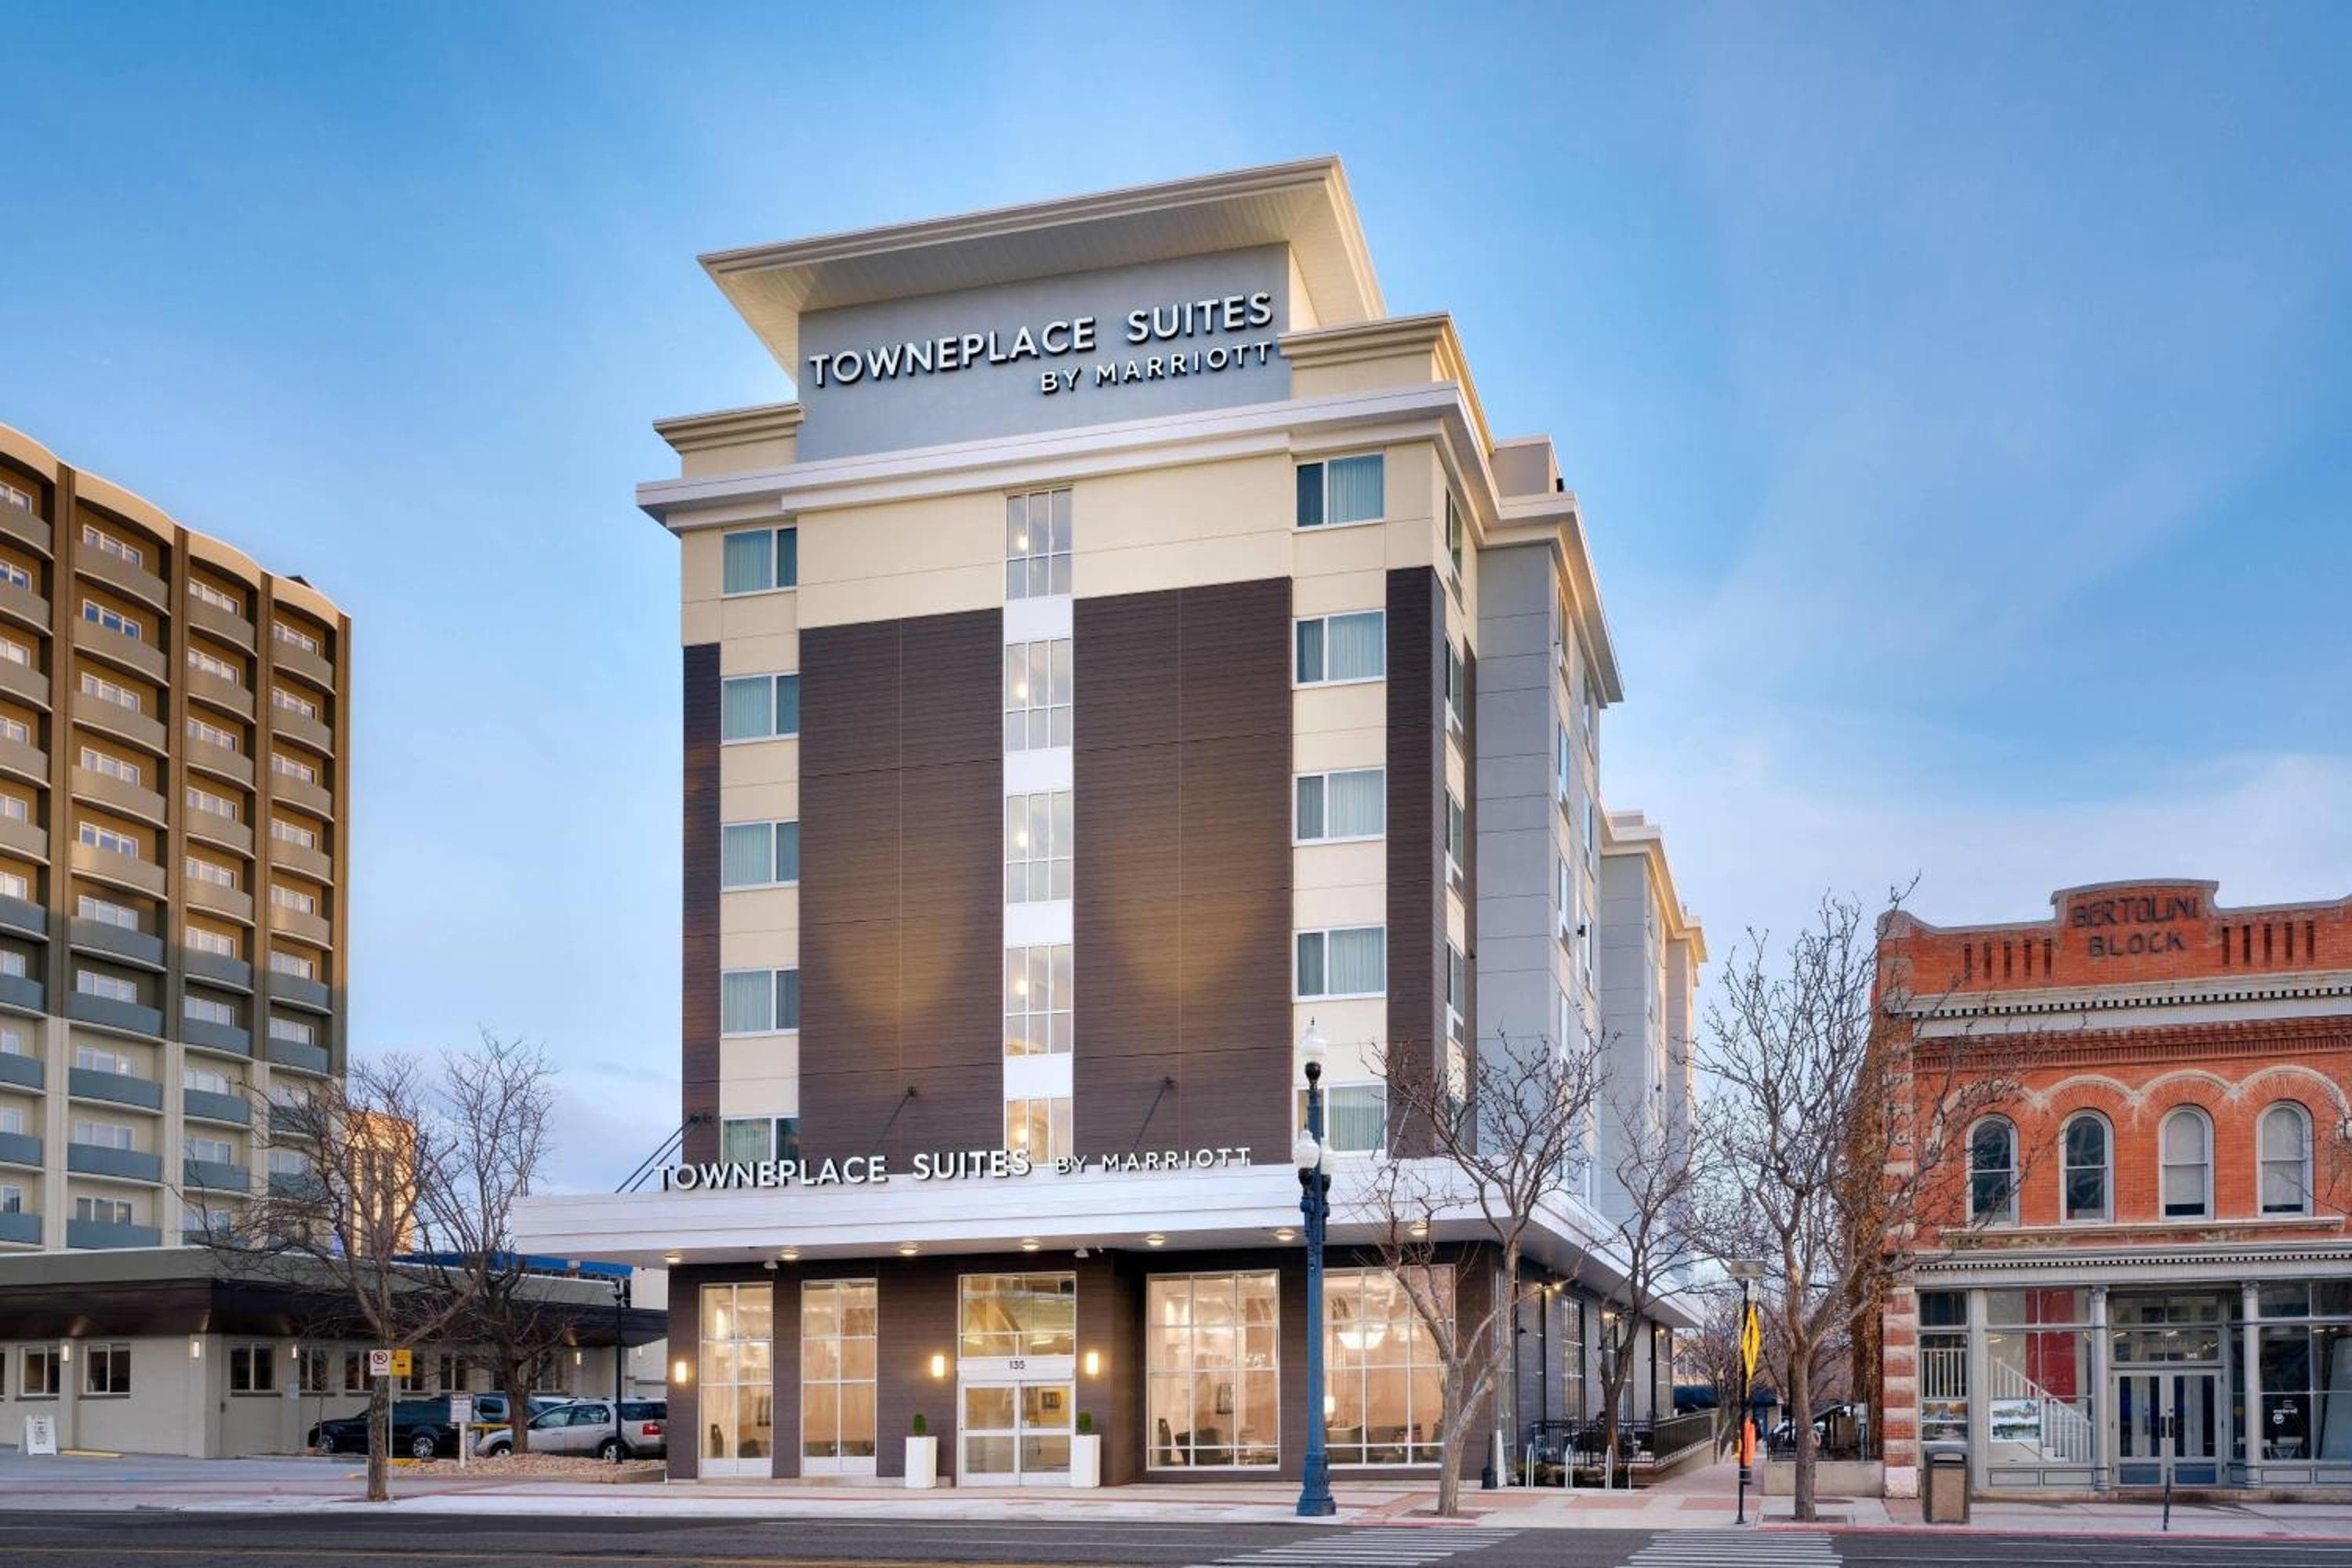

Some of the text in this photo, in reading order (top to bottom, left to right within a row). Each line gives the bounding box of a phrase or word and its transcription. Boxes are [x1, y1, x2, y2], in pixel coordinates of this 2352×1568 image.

[809, 292, 1273, 387] TOWNEPLACE SUITES
[1041, 341, 1272, 394] BY MARRIOTT
[2089, 931, 2184, 956] BLOCK
[654, 1147, 1251, 1191] TOWNEPLACE SUITES BY MARRIOTT
[1009, 1360, 1025, 1370] 135
